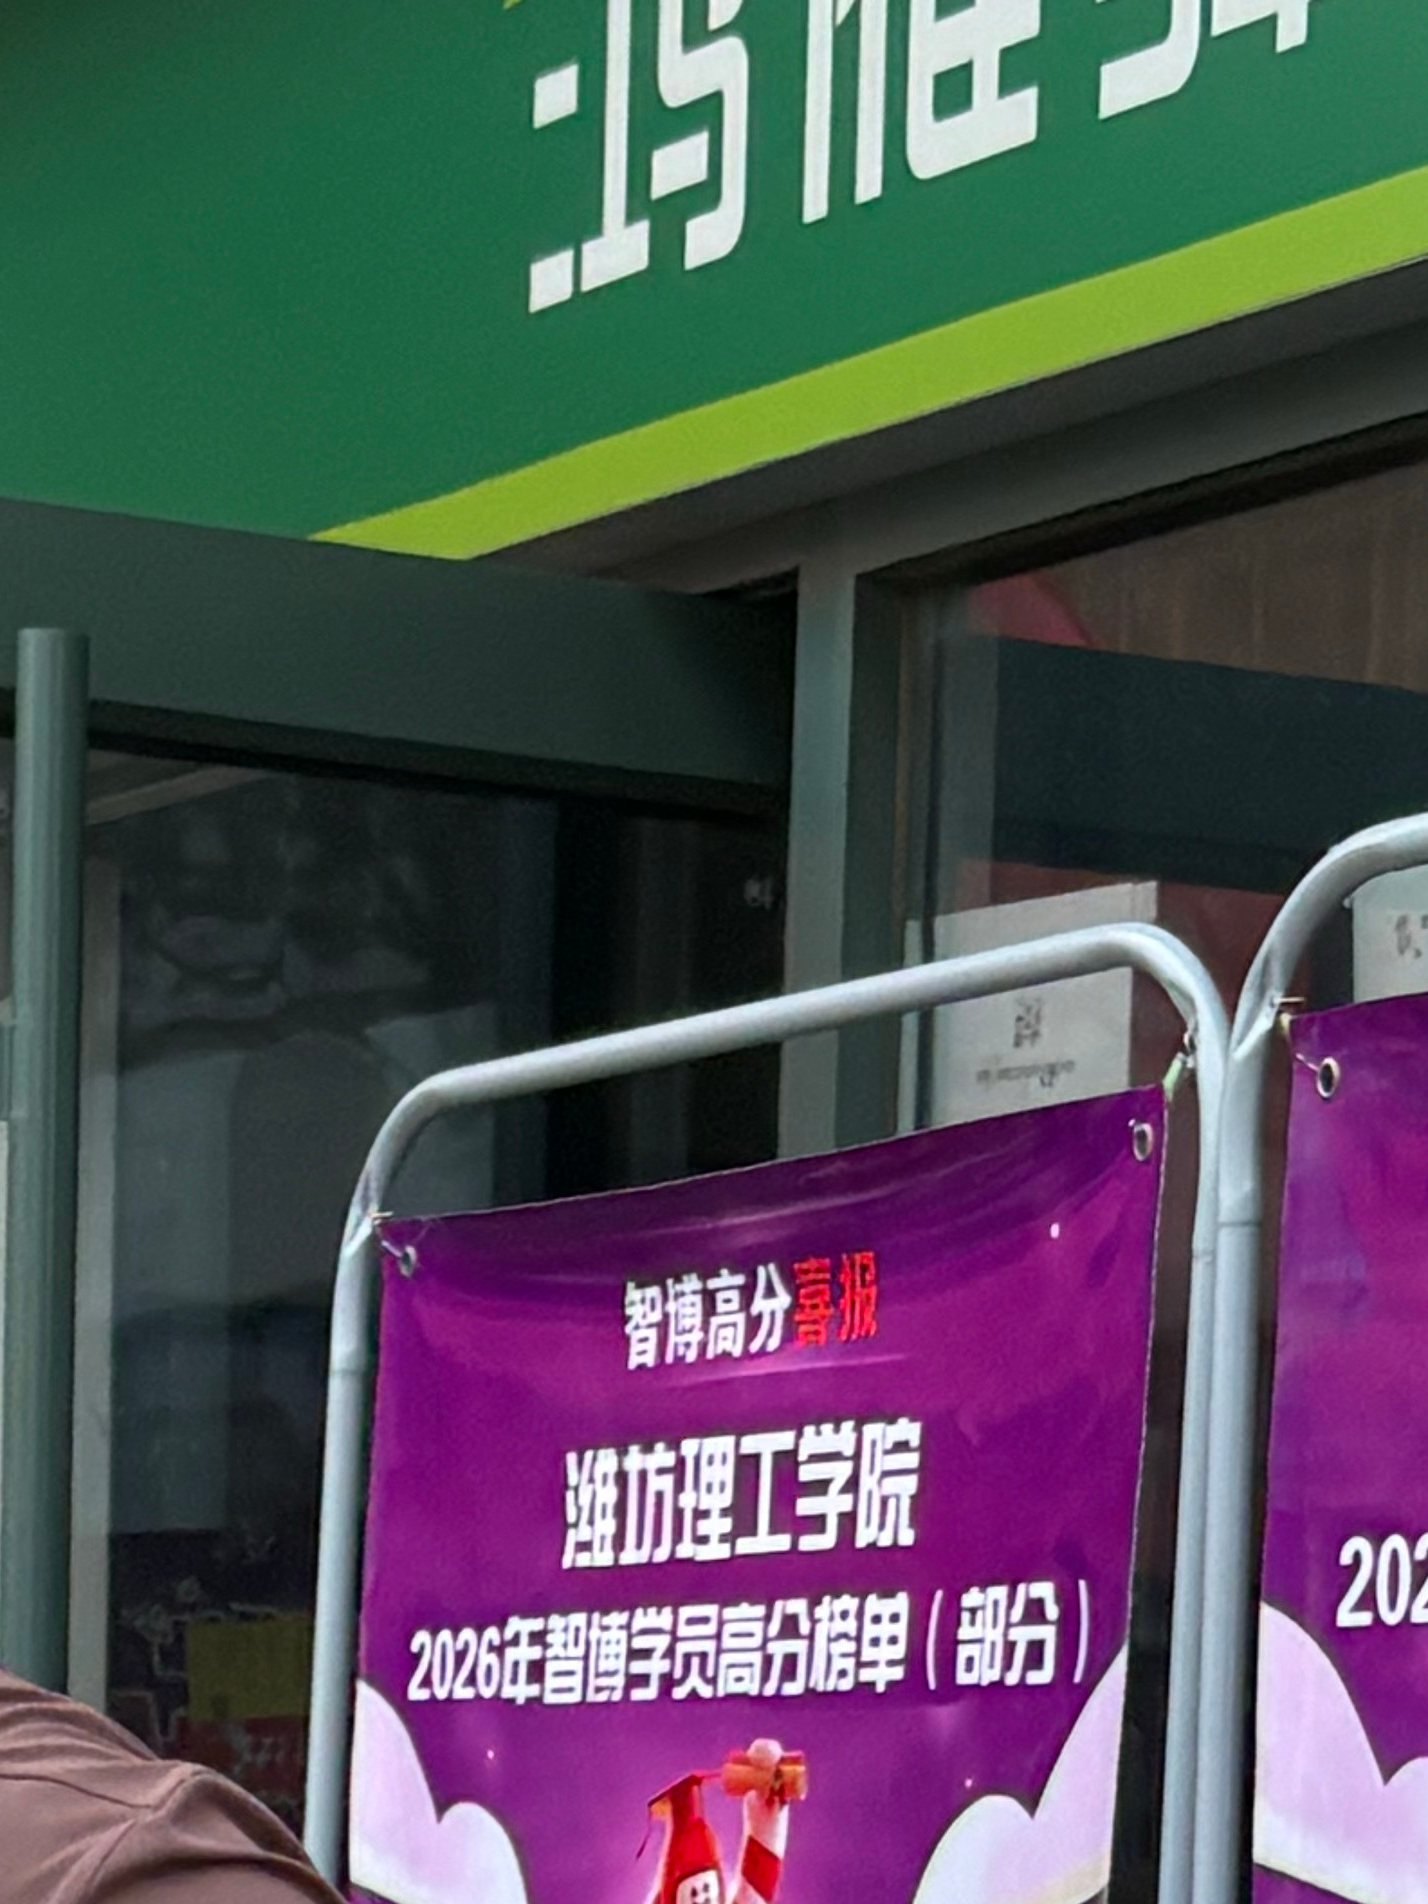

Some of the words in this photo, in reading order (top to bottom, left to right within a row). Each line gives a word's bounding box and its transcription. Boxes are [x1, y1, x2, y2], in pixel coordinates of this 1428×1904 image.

[623, 1251, 878, 1370] 智博高分喜报
[562, 1419, 922, 1570] 潍坊理工学院
